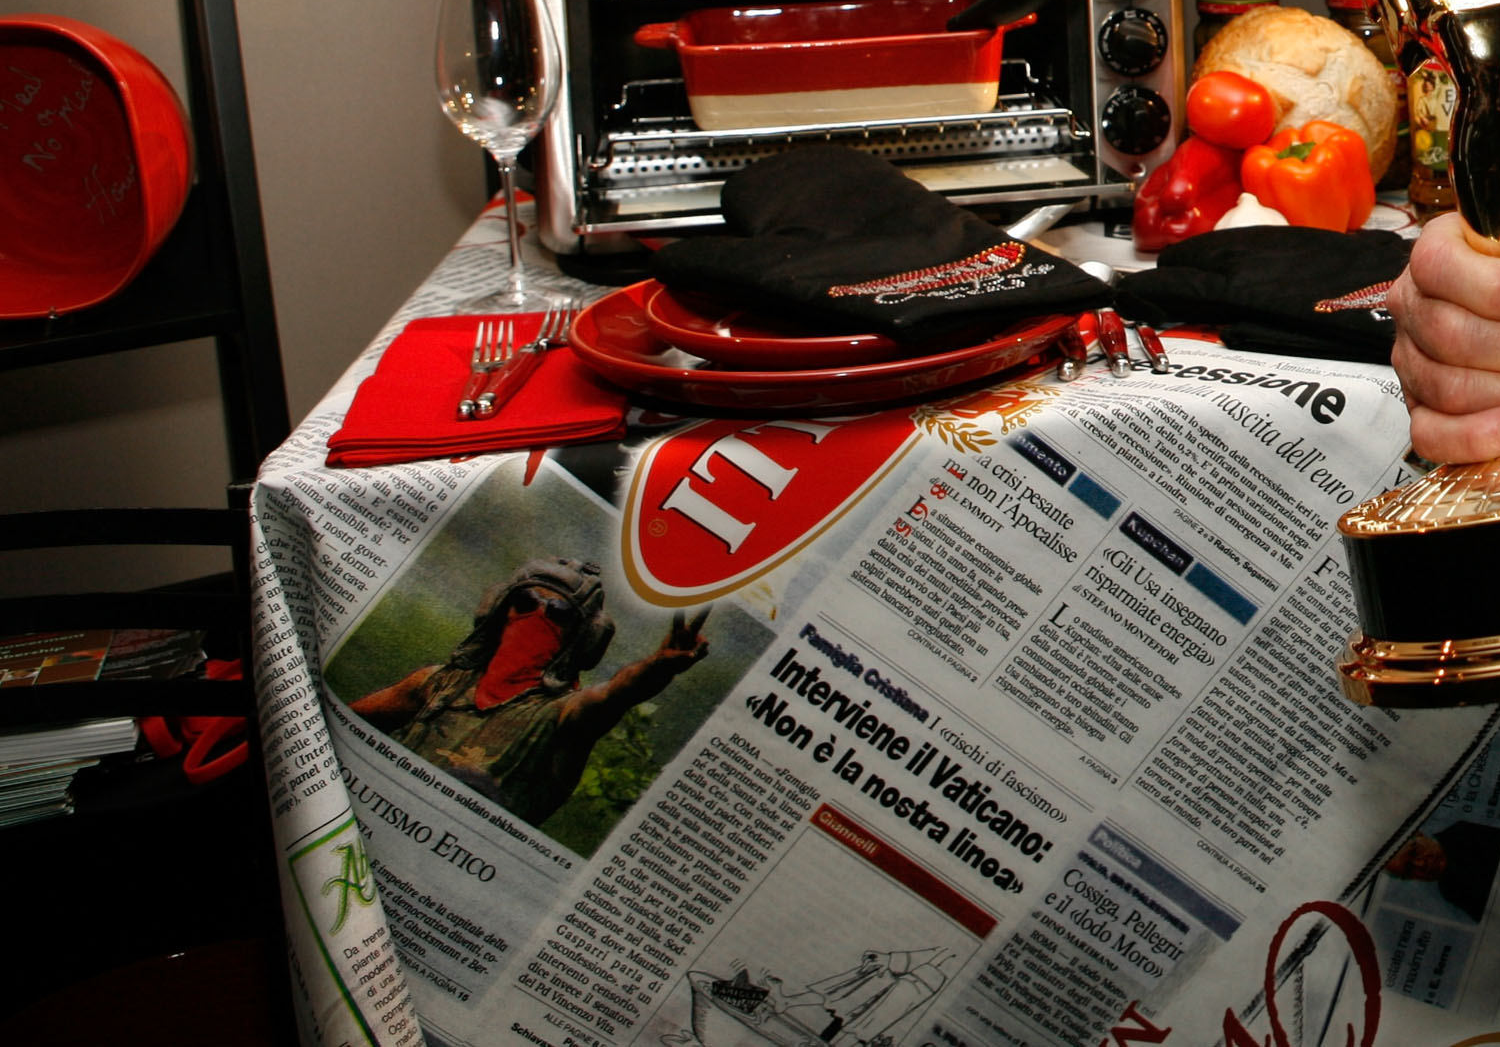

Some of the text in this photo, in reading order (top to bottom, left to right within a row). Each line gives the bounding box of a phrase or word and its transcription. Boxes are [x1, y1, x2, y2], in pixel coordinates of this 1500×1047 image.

[991, 464, 1027, 492] crisi
[1017, 485, 1074, 530] pesante
[1111, 408, 1304, 562] dell'euro. Tanto che ormai nessuno considera
[1184, 429, 1197, 445] ha
[1196, 441, 1240, 478] certificato
[1239, 475, 1258, 492] una
[1256, 489, 1307, 530] contrazione
[1305, 527, 1323, 542] del
[1211, 393, 1354, 504] nascita dell'euro
[965, 475, 997, 503] non
[995, 493, 1078, 563] l'Apocalisse
[1084, 565, 1215, 666] risparmiate energia»
[1102, 547, 1227, 646] «Gli Usa insegnano
[769, 647, 1053, 863] Interviene il Vaticano:
[798, 622, 1067, 823] Famiglia Cristiana I «rischi di fascismo»
[339, 765, 433, 844] OLUTISMO
[745, 691, 814, 751] «Non
[812, 733, 837, 763] è
[831, 747, 864, 785] la
[860, 773, 950, 844] nostra
[946, 827, 1023, 894] linea»
